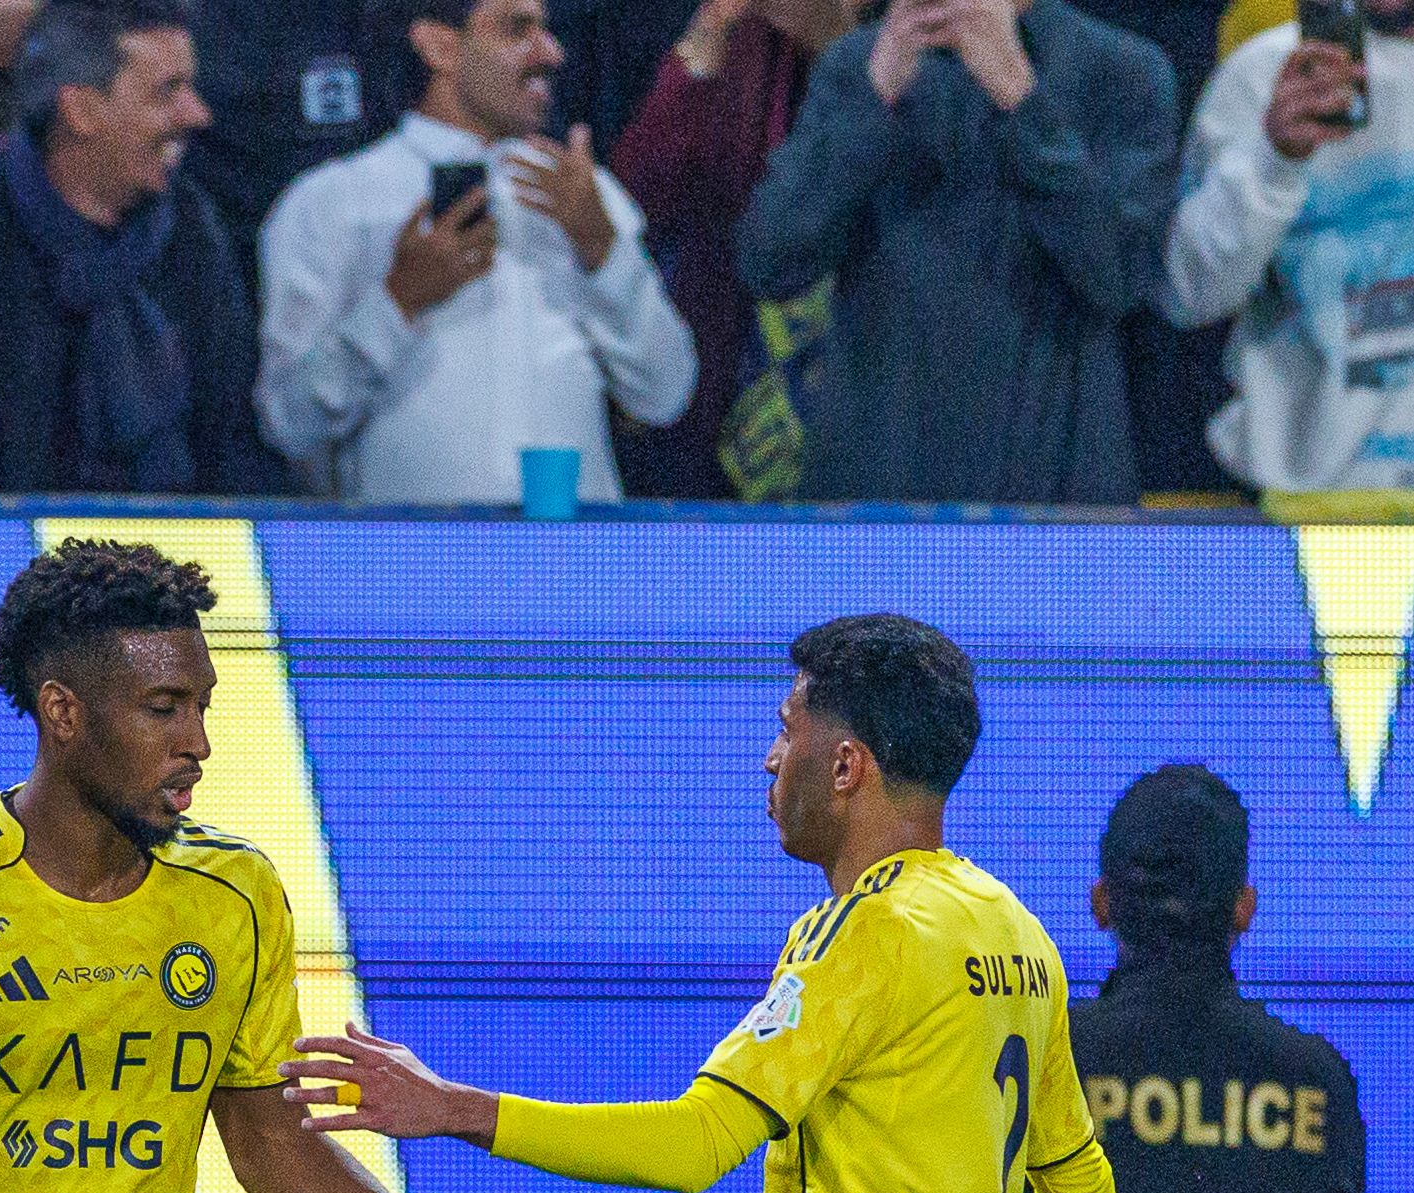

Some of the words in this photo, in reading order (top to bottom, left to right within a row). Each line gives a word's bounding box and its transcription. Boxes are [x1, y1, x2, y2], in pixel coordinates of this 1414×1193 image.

[964, 955, 1049, 999] SULTAN
[1087, 1074, 1327, 1154] POLICE
[42, 1118, 164, 1170] SHG
